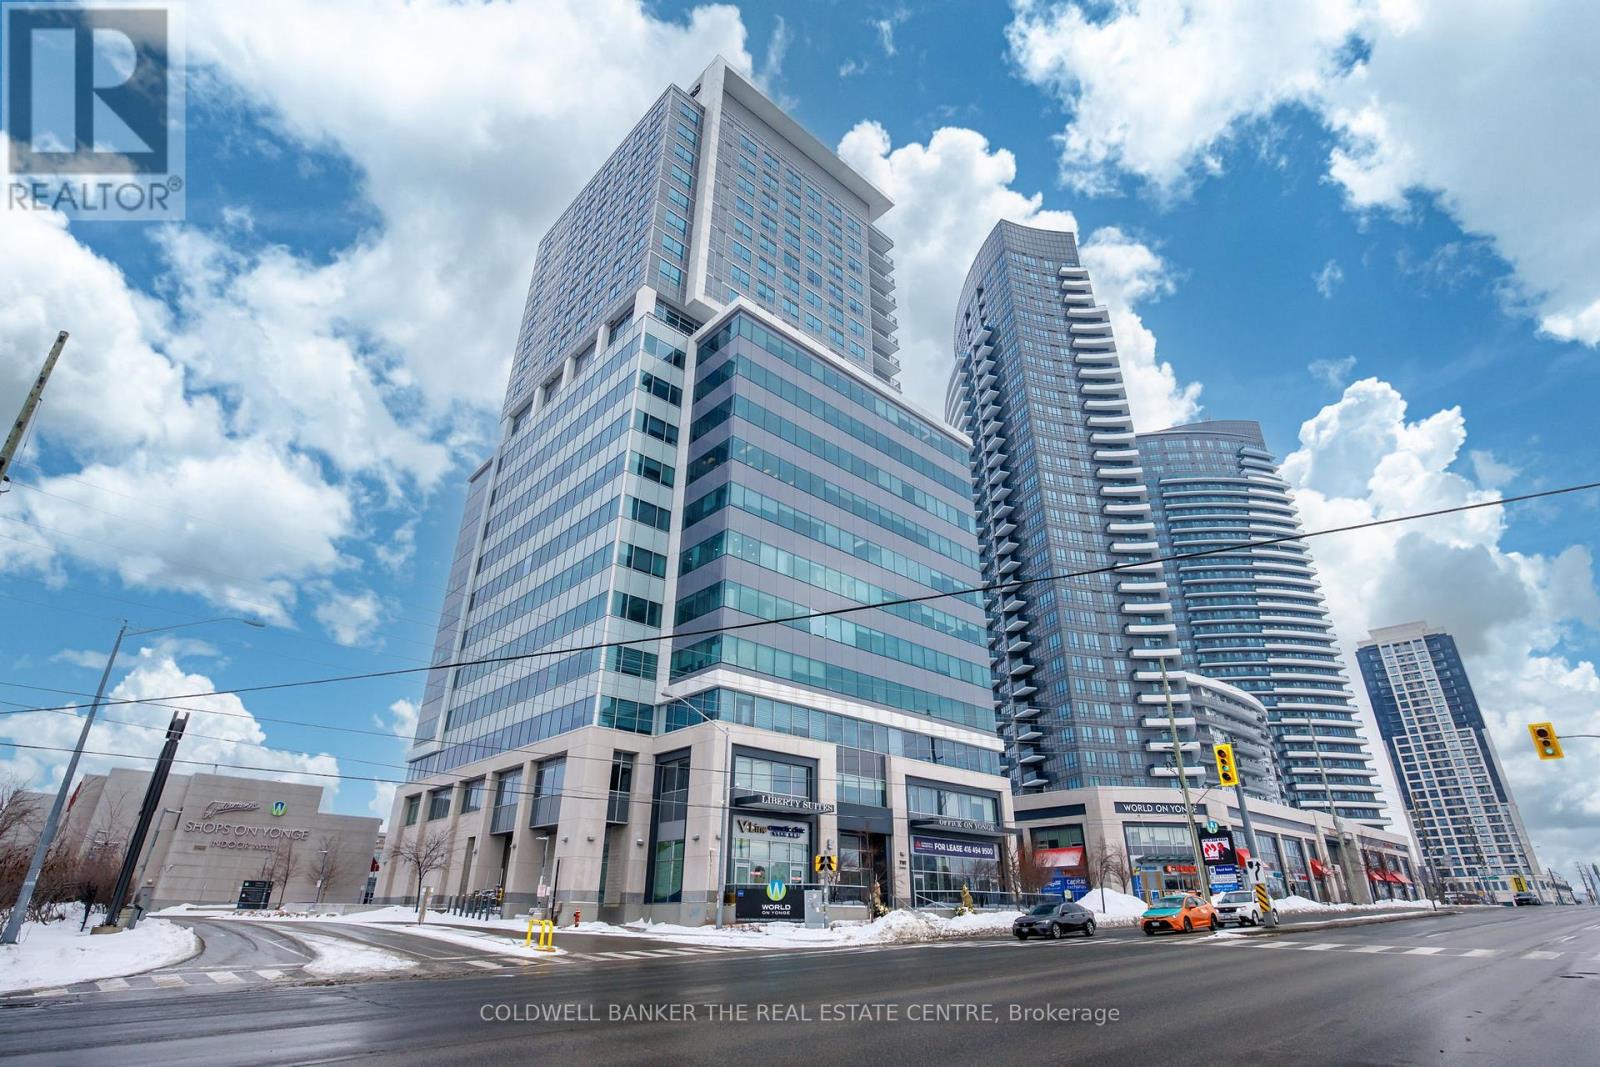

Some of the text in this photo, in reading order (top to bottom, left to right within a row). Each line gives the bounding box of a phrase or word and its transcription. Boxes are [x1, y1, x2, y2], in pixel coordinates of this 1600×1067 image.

[761, 795, 834, 812] LIBERTY SUITES
[1123, 804, 1198, 813] WORLD ON YONE
[938, 819, 962, 828] OFFICE
[963, 821, 973, 829] ON
[184, 820, 310, 841] SHOPS ON YONGE
[934, 842, 946, 851] FOR
[946, 844, 963, 853] LEASE
